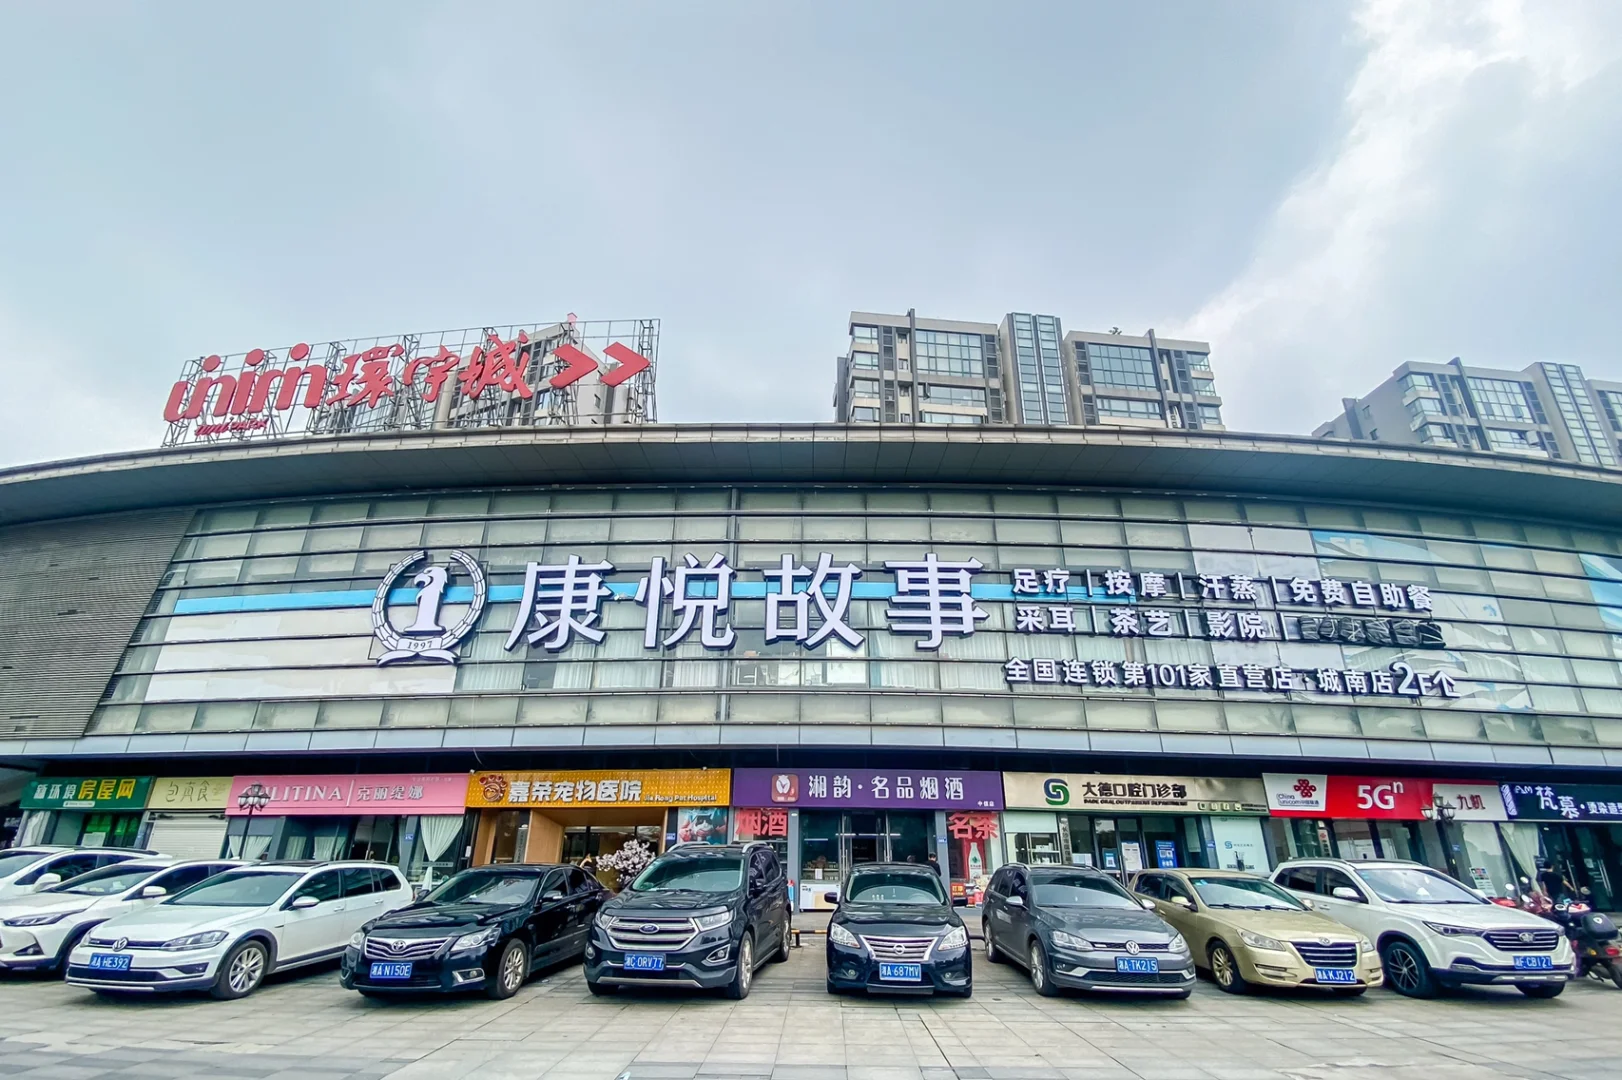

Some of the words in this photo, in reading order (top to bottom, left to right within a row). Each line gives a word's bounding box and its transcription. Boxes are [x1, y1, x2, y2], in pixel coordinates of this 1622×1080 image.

[503, 551, 991, 652] 康悦故事
[1012, 568, 1072, 595] 足疗
[1105, 570, 1168, 599] 按摩
[1197, 572, 1258, 602] 汗蒸
[1289, 577, 1434, 612] 免费自助餐
[1015, 606, 1076, 632] 采耳
[1109, 608, 1173, 637] 茶艺
[1205, 610, 1267, 639] 影院
[407, 639, 433, 650] 1997
[508, 780, 642, 803] 嘉荣宠物医院
[1082, 781, 1187, 799] 大德口腔门诊部
[736, 809, 788, 837] 烟酒
[948, 812, 998, 839] 名茶
